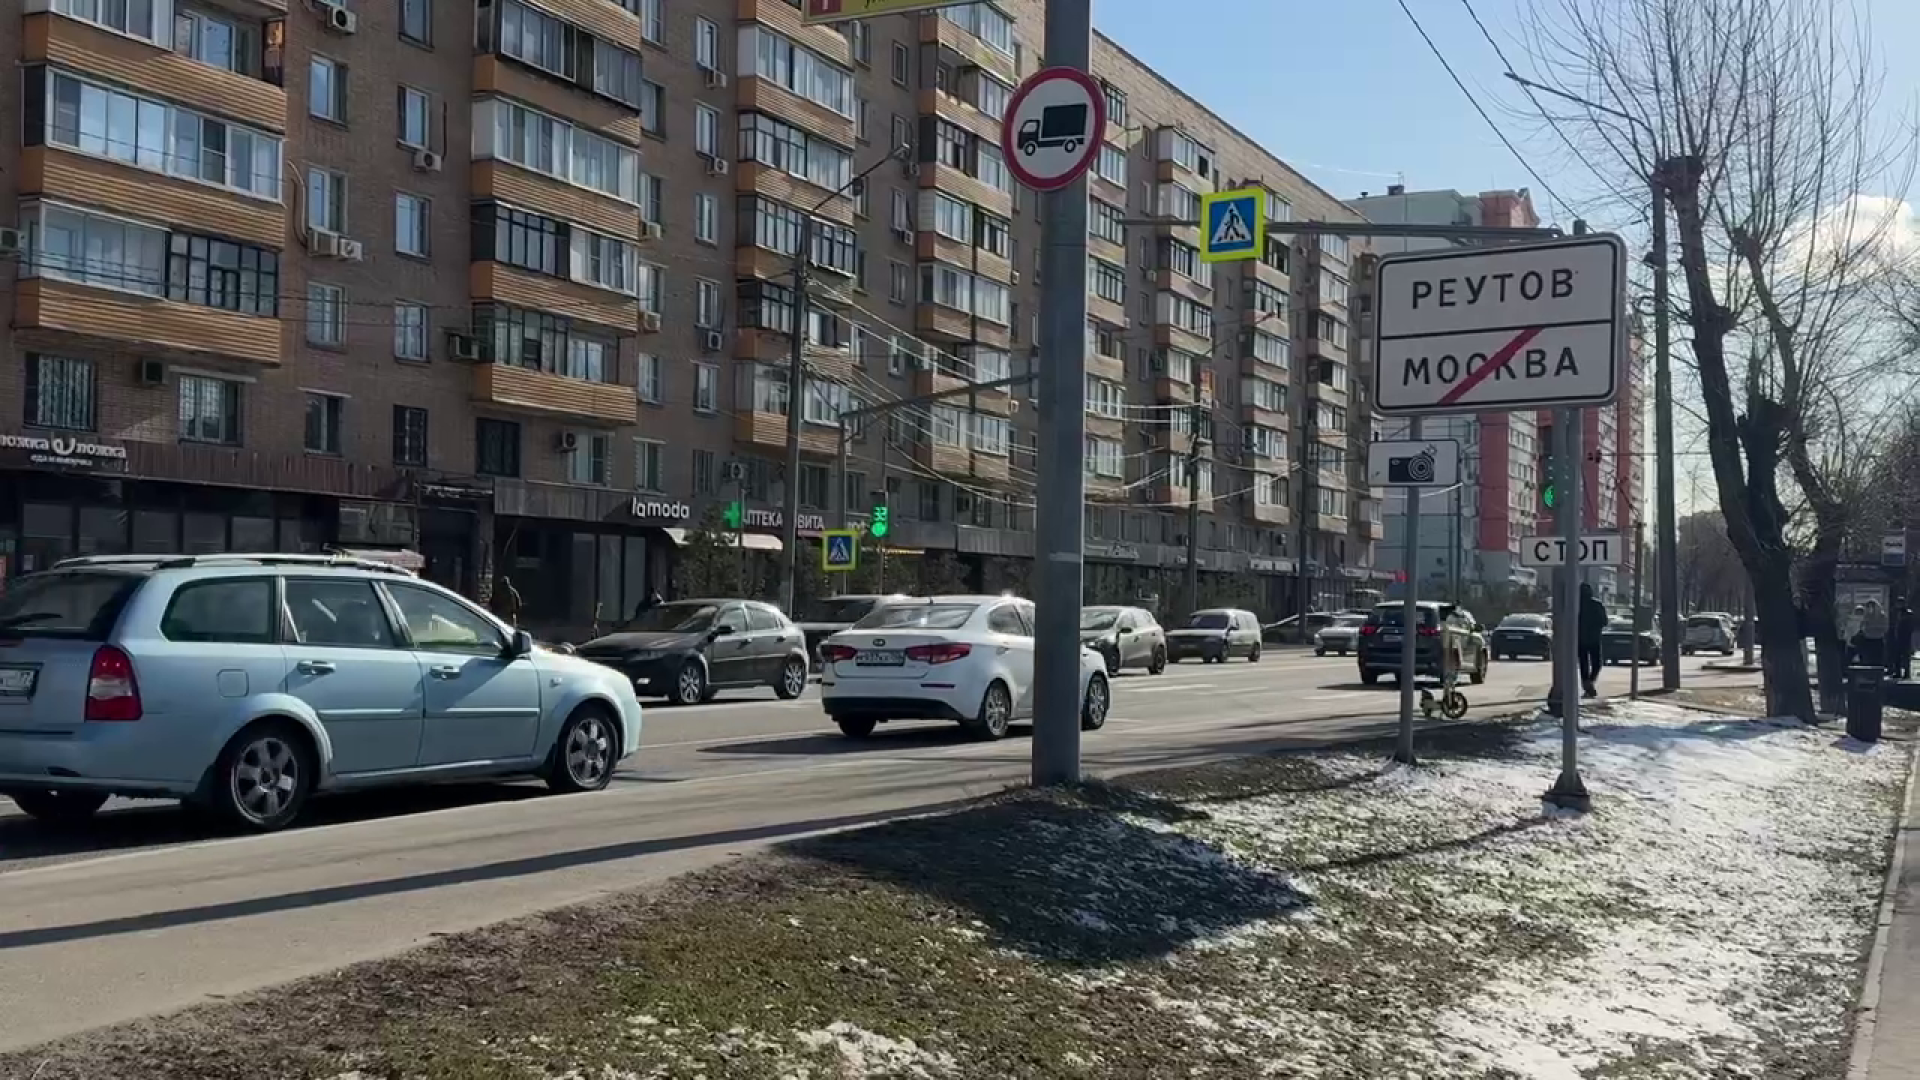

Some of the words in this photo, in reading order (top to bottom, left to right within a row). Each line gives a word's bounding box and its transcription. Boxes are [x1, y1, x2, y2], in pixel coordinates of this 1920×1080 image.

[1412, 268, 1574, 310] РЕУТОВ
[1402, 346, 1579, 387] МОСКВА
[632, 496, 690, 519] lamoda
[744, 509, 784, 527] ПТЕКА
[797, 514, 825, 530] ВИТА
[1533, 540, 1608, 562] СТОП
